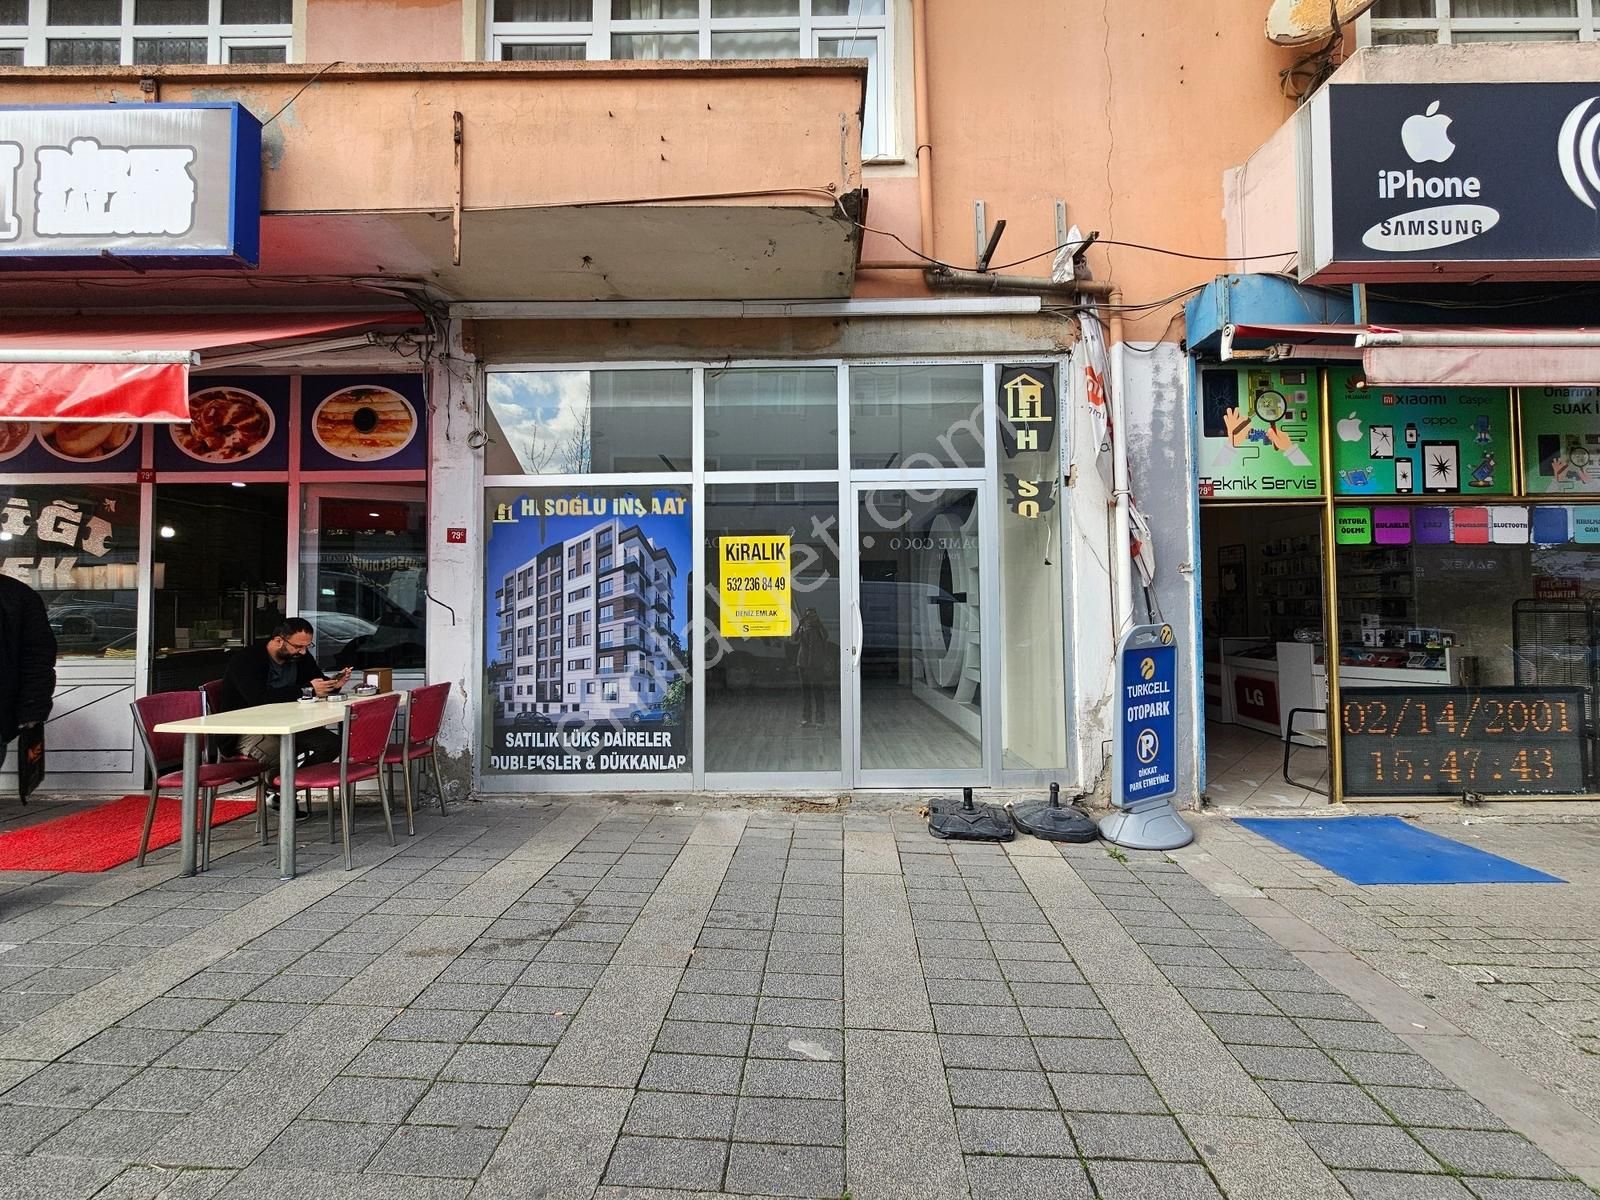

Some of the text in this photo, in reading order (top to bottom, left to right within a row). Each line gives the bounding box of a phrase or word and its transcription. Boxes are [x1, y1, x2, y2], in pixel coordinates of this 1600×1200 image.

[1378, 170, 1480, 198] iPhone
[1380, 220, 1482, 236] SAMSUNG
[1553, 403, 1592, 414] SUAK
[1199, 476, 1316, 490] Teknik Servis
[727, 577, 742, 591] 532
[745, 577, 759, 590] 236
[775, 577, 785, 590] 49
[756, 609, 778, 617] EMLAK
[1127, 681, 1170, 698] TURKCELL
[1245, 688, 1264, 706] LG
[1127, 701, 1170, 722] OTOPARK
[1344, 698, 1573, 738] 02/14/2001
[505, 728, 671, 747] SATILIK LÜKS DAİRELER
[491, 755, 581, 770] DUBLEKSLER
[585, 754, 596, 770] &
[1371, 748, 1554, 782] 15:47:43
[1138, 765, 1158, 777] DİKKAT
[1129, 781, 1142, 792] PARK
